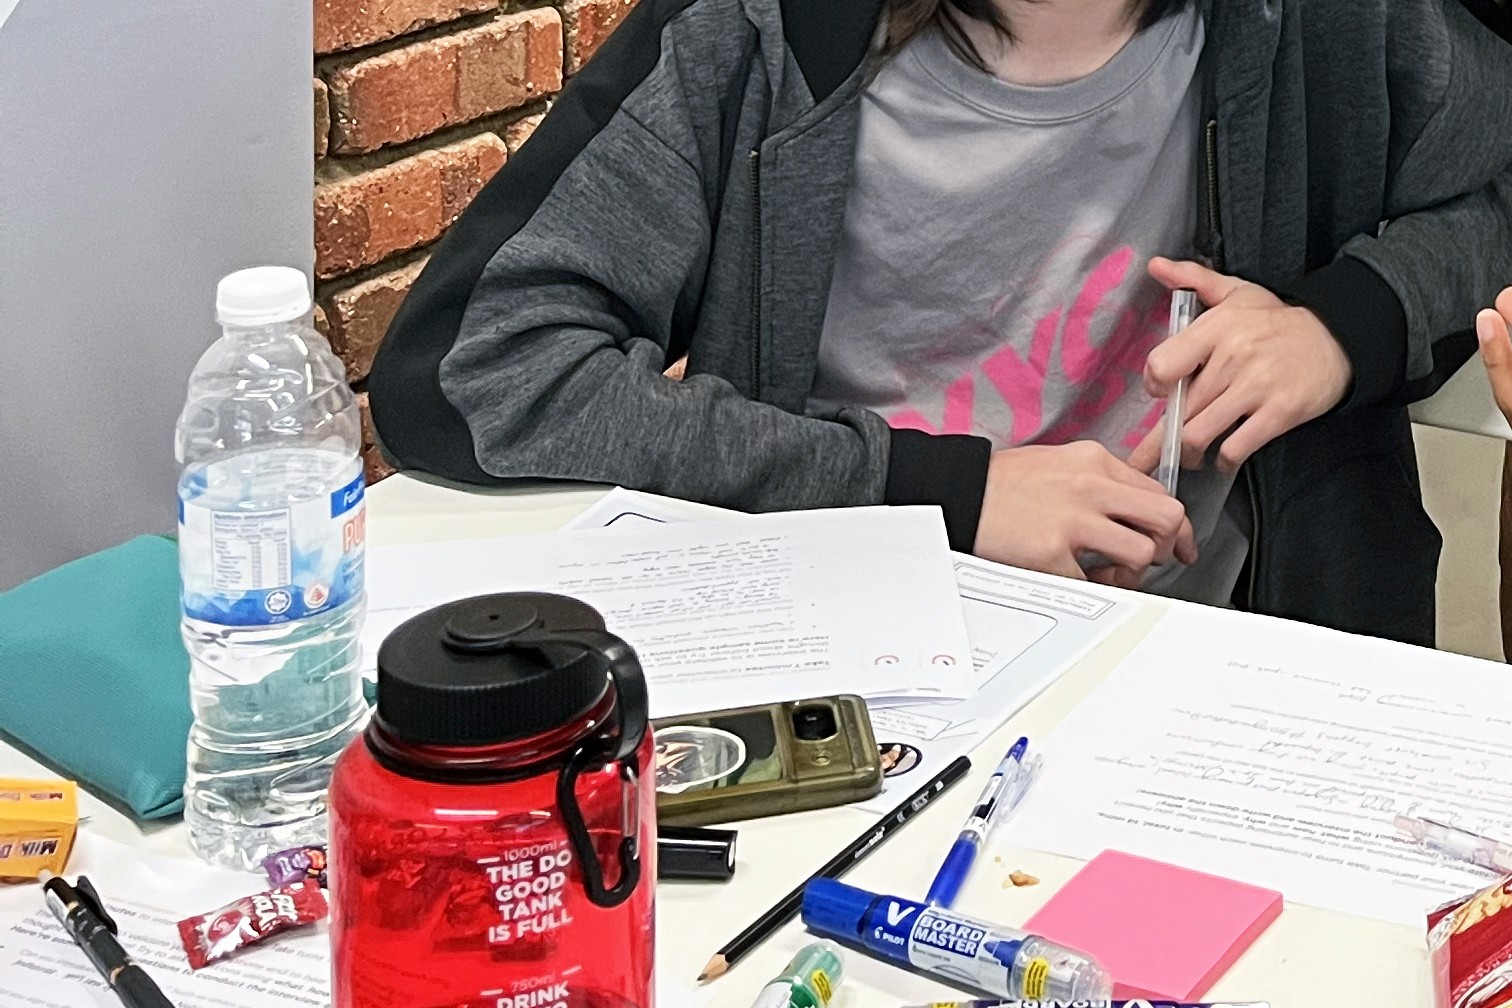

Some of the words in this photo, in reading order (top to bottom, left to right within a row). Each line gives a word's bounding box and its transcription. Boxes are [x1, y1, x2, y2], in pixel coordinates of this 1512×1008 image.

[503, 841, 558, 861] 1000ml
[487, 861, 534, 884] THE
[539, 849, 572, 873] DO
[495, 872, 566, 902] GOOD
[499, 891, 563, 921] TANK
[488, 925, 511, 943] IS
[517, 908, 574, 938] FULL
[913, 925, 979, 956] MASTER
[918, 914, 988, 941] BOARD
[496, 981, 570, 1008] DRINK
[510, 973, 556, 992] 750ml
